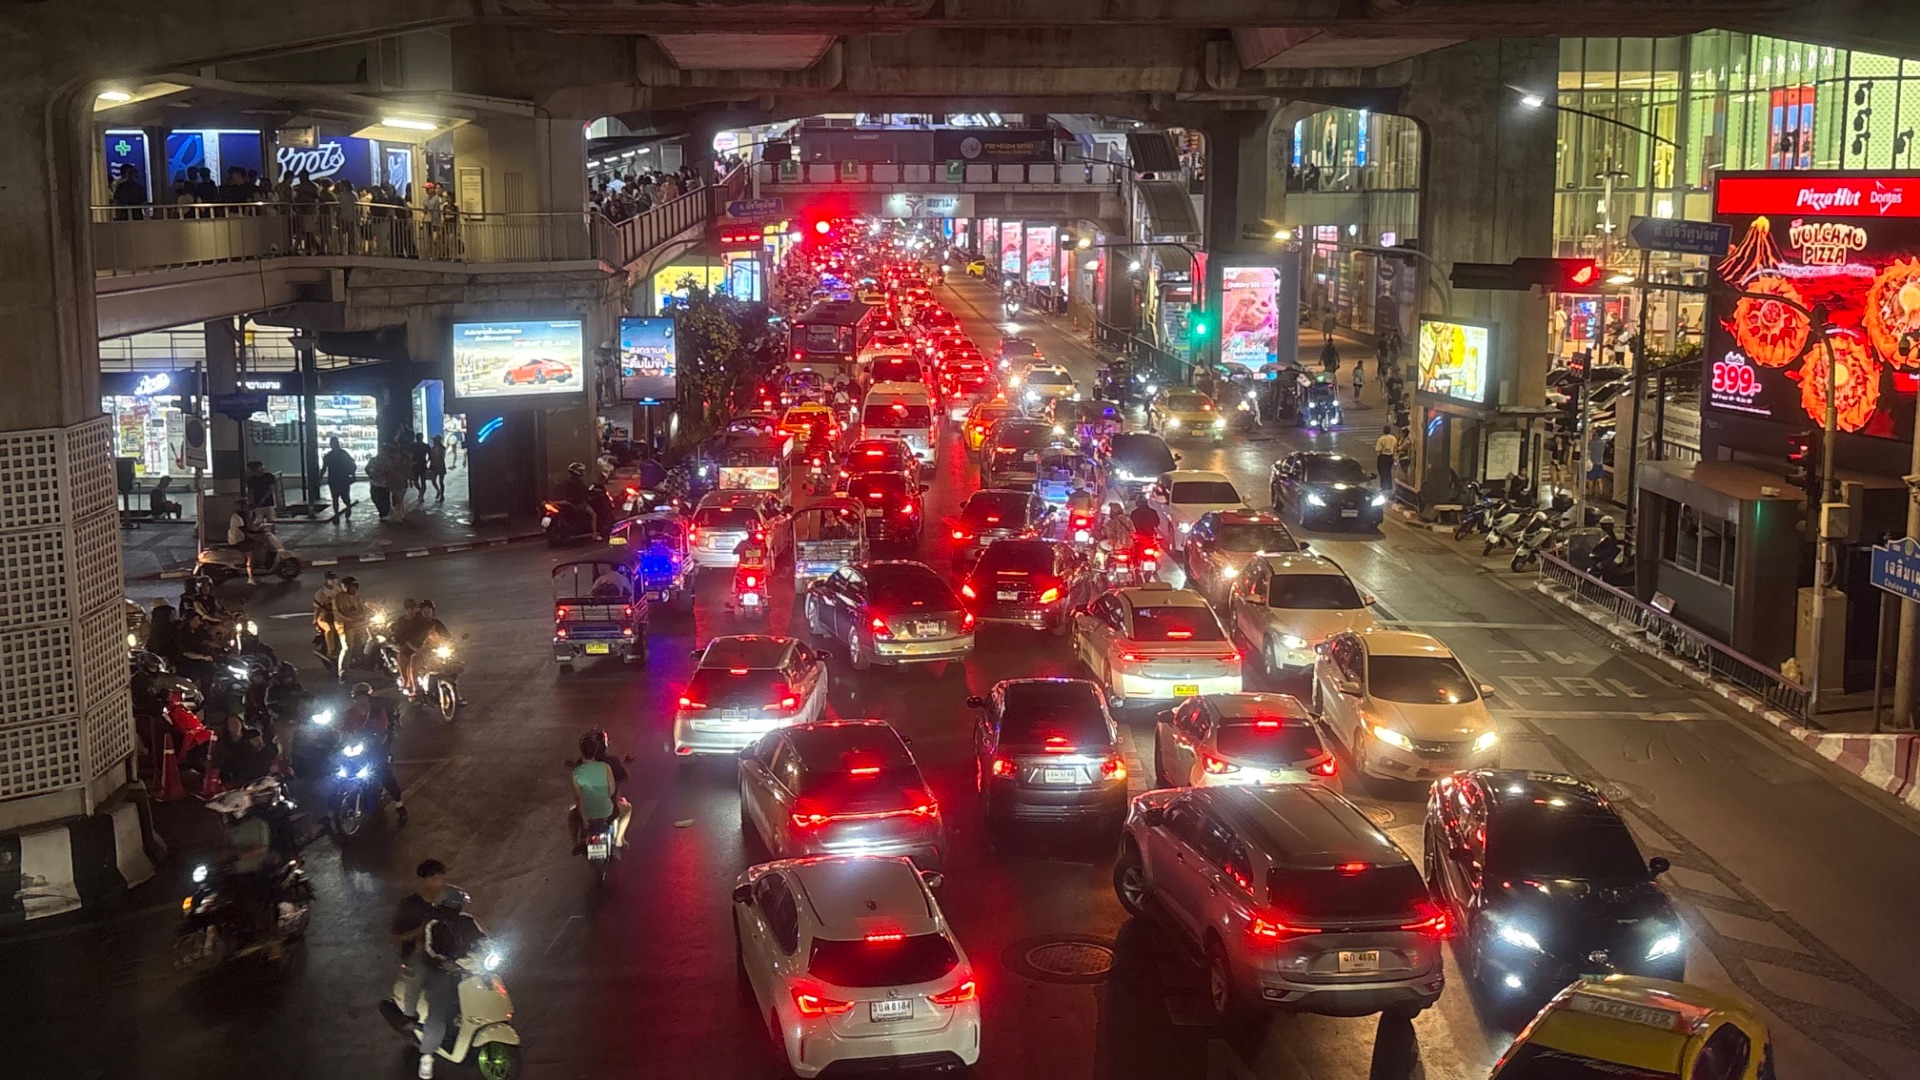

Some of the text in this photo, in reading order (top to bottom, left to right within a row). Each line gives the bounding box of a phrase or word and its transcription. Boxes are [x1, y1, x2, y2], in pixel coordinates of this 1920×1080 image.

[1762, 48, 1835, 76] PRADA
[1870, 190, 1902, 204] Doritos
[1789, 223, 1867, 250] VOLCANO
[1803, 245, 1847, 265] PIZZA
[629, 344, 668, 354] สงกรานต์
[891, 1001, 910, 1010] 8184
